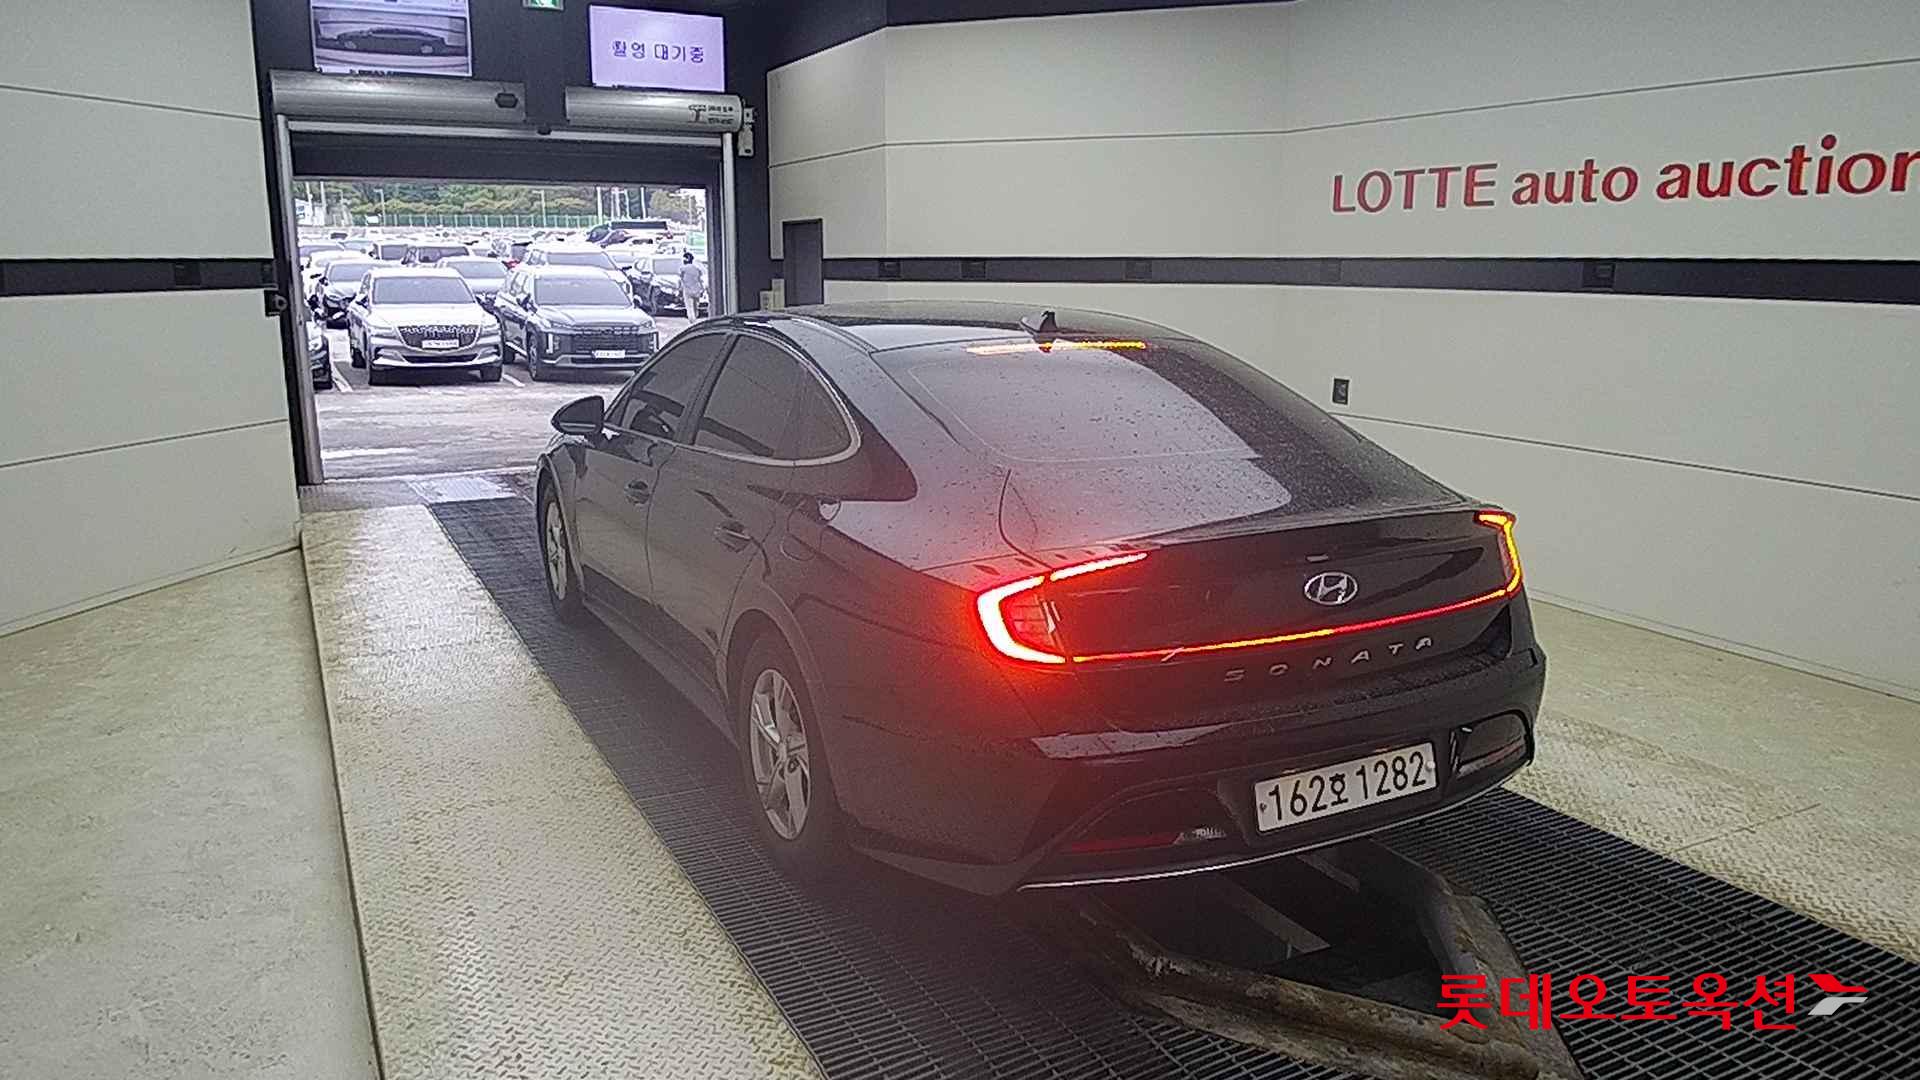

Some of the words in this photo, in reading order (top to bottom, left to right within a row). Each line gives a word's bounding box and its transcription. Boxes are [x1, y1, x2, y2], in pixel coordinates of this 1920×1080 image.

[1332, 163, 1497, 213] LOTTE
[1511, 159, 1638, 205] auto
[1224, 637, 1433, 682] SONATA
